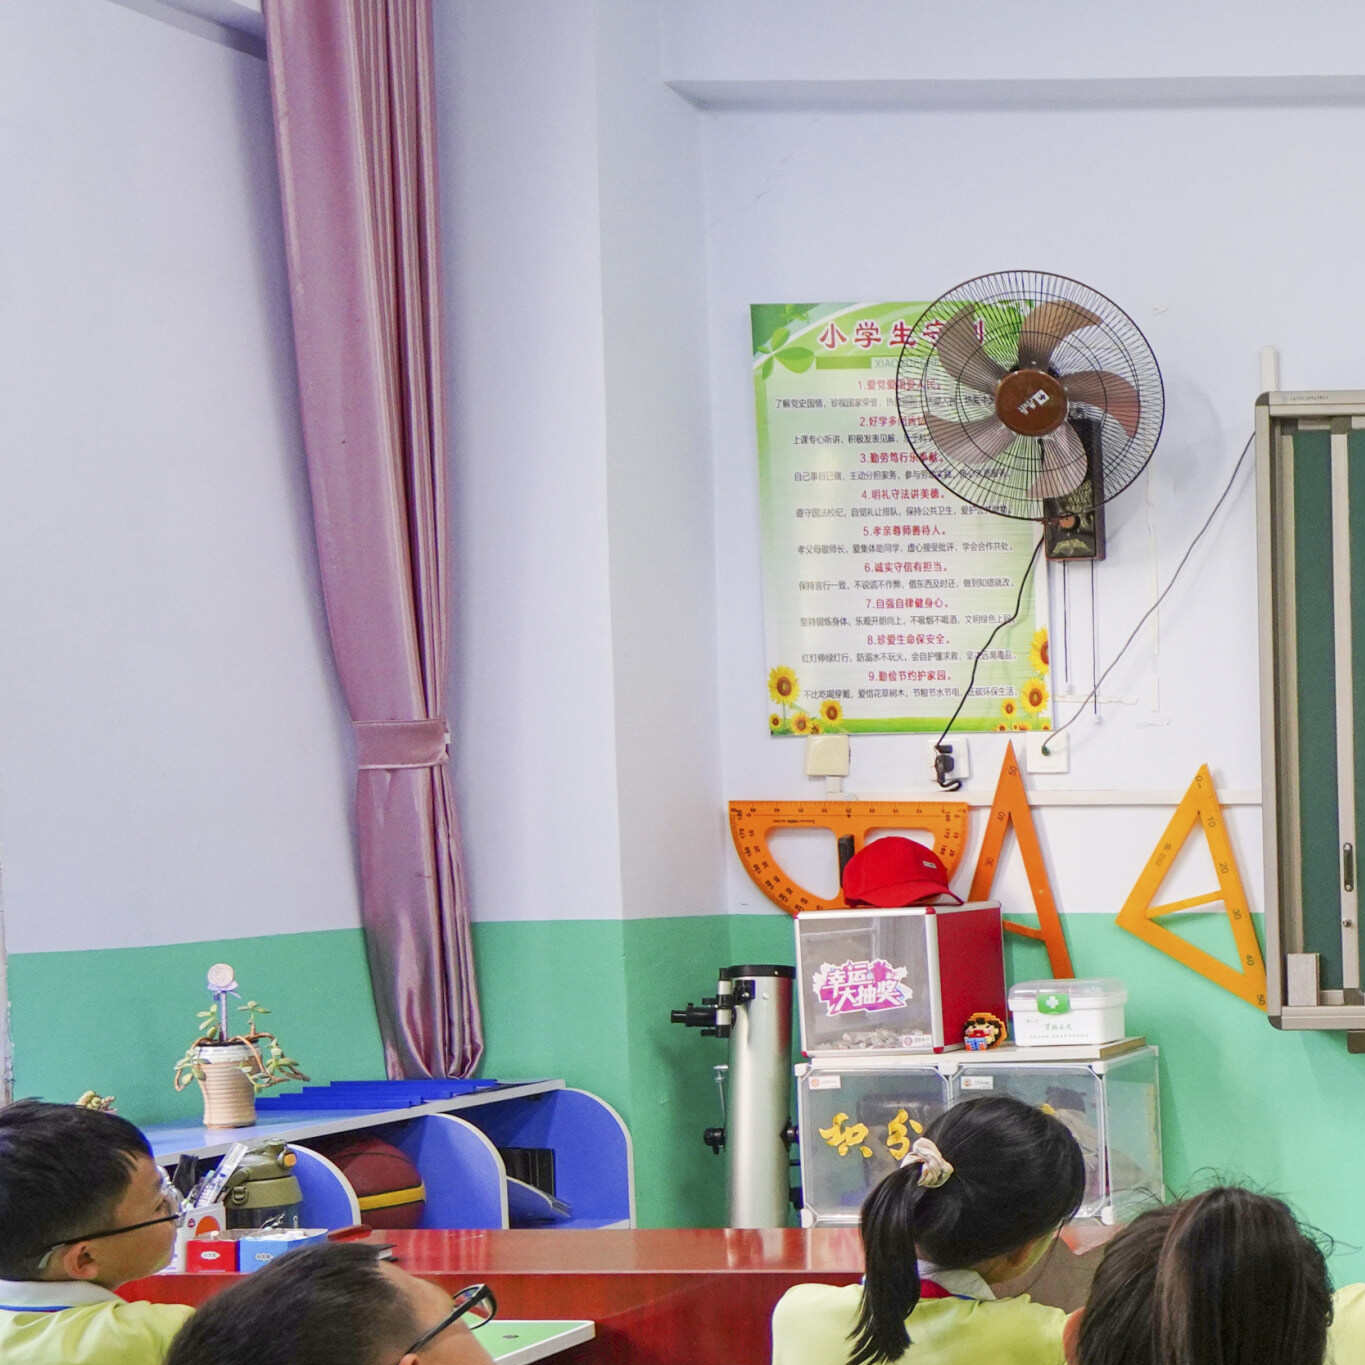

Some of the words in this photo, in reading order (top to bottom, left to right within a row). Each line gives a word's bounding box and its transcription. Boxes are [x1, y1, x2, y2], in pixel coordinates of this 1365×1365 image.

[819, 320, 984, 348] 小学生守
[1208, 816, 1216, 828] 10
[1220, 863, 1229, 874] 20
[1233, 909, 1241, 921] 30
[821, 960, 874, 1000] 幸运
[834, 980, 906, 1012] 大抽奖
